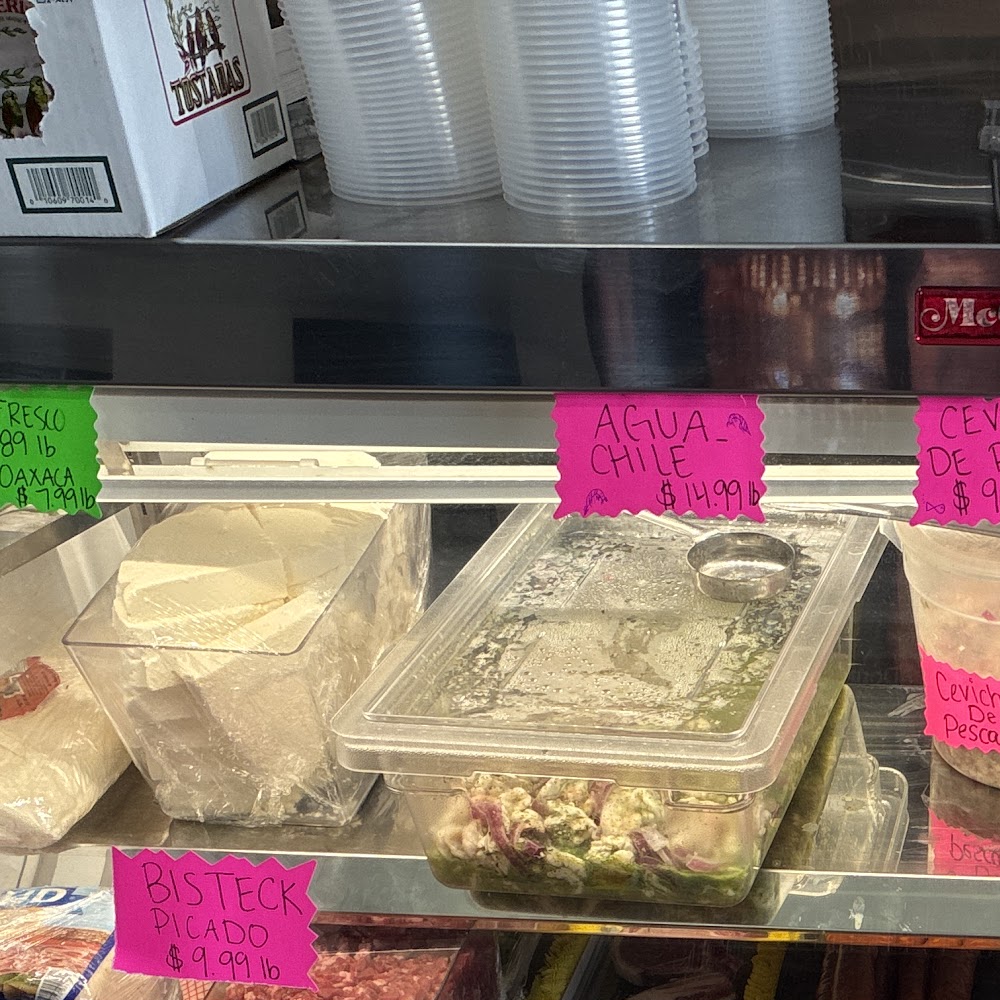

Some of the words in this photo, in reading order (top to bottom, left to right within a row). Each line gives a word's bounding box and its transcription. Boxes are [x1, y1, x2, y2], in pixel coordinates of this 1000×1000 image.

[170, 56, 244, 116] TOSTADAS
[0, 401, 66, 432] RESCO
[37, 435, 56, 458] lb
[591, 444, 694, 479] CHILE
[926, 446, 972, 476] DE
[0, 464, 75, 488] OAXACA
[80, 487, 96, 509] lb
[748, 480, 761, 507] lb
[968, 704, 996, 724] De
[141, 862, 303, 916] BISTECK
[150, 908, 269, 948] PICADO
[260, 956, 281, 980] lb
